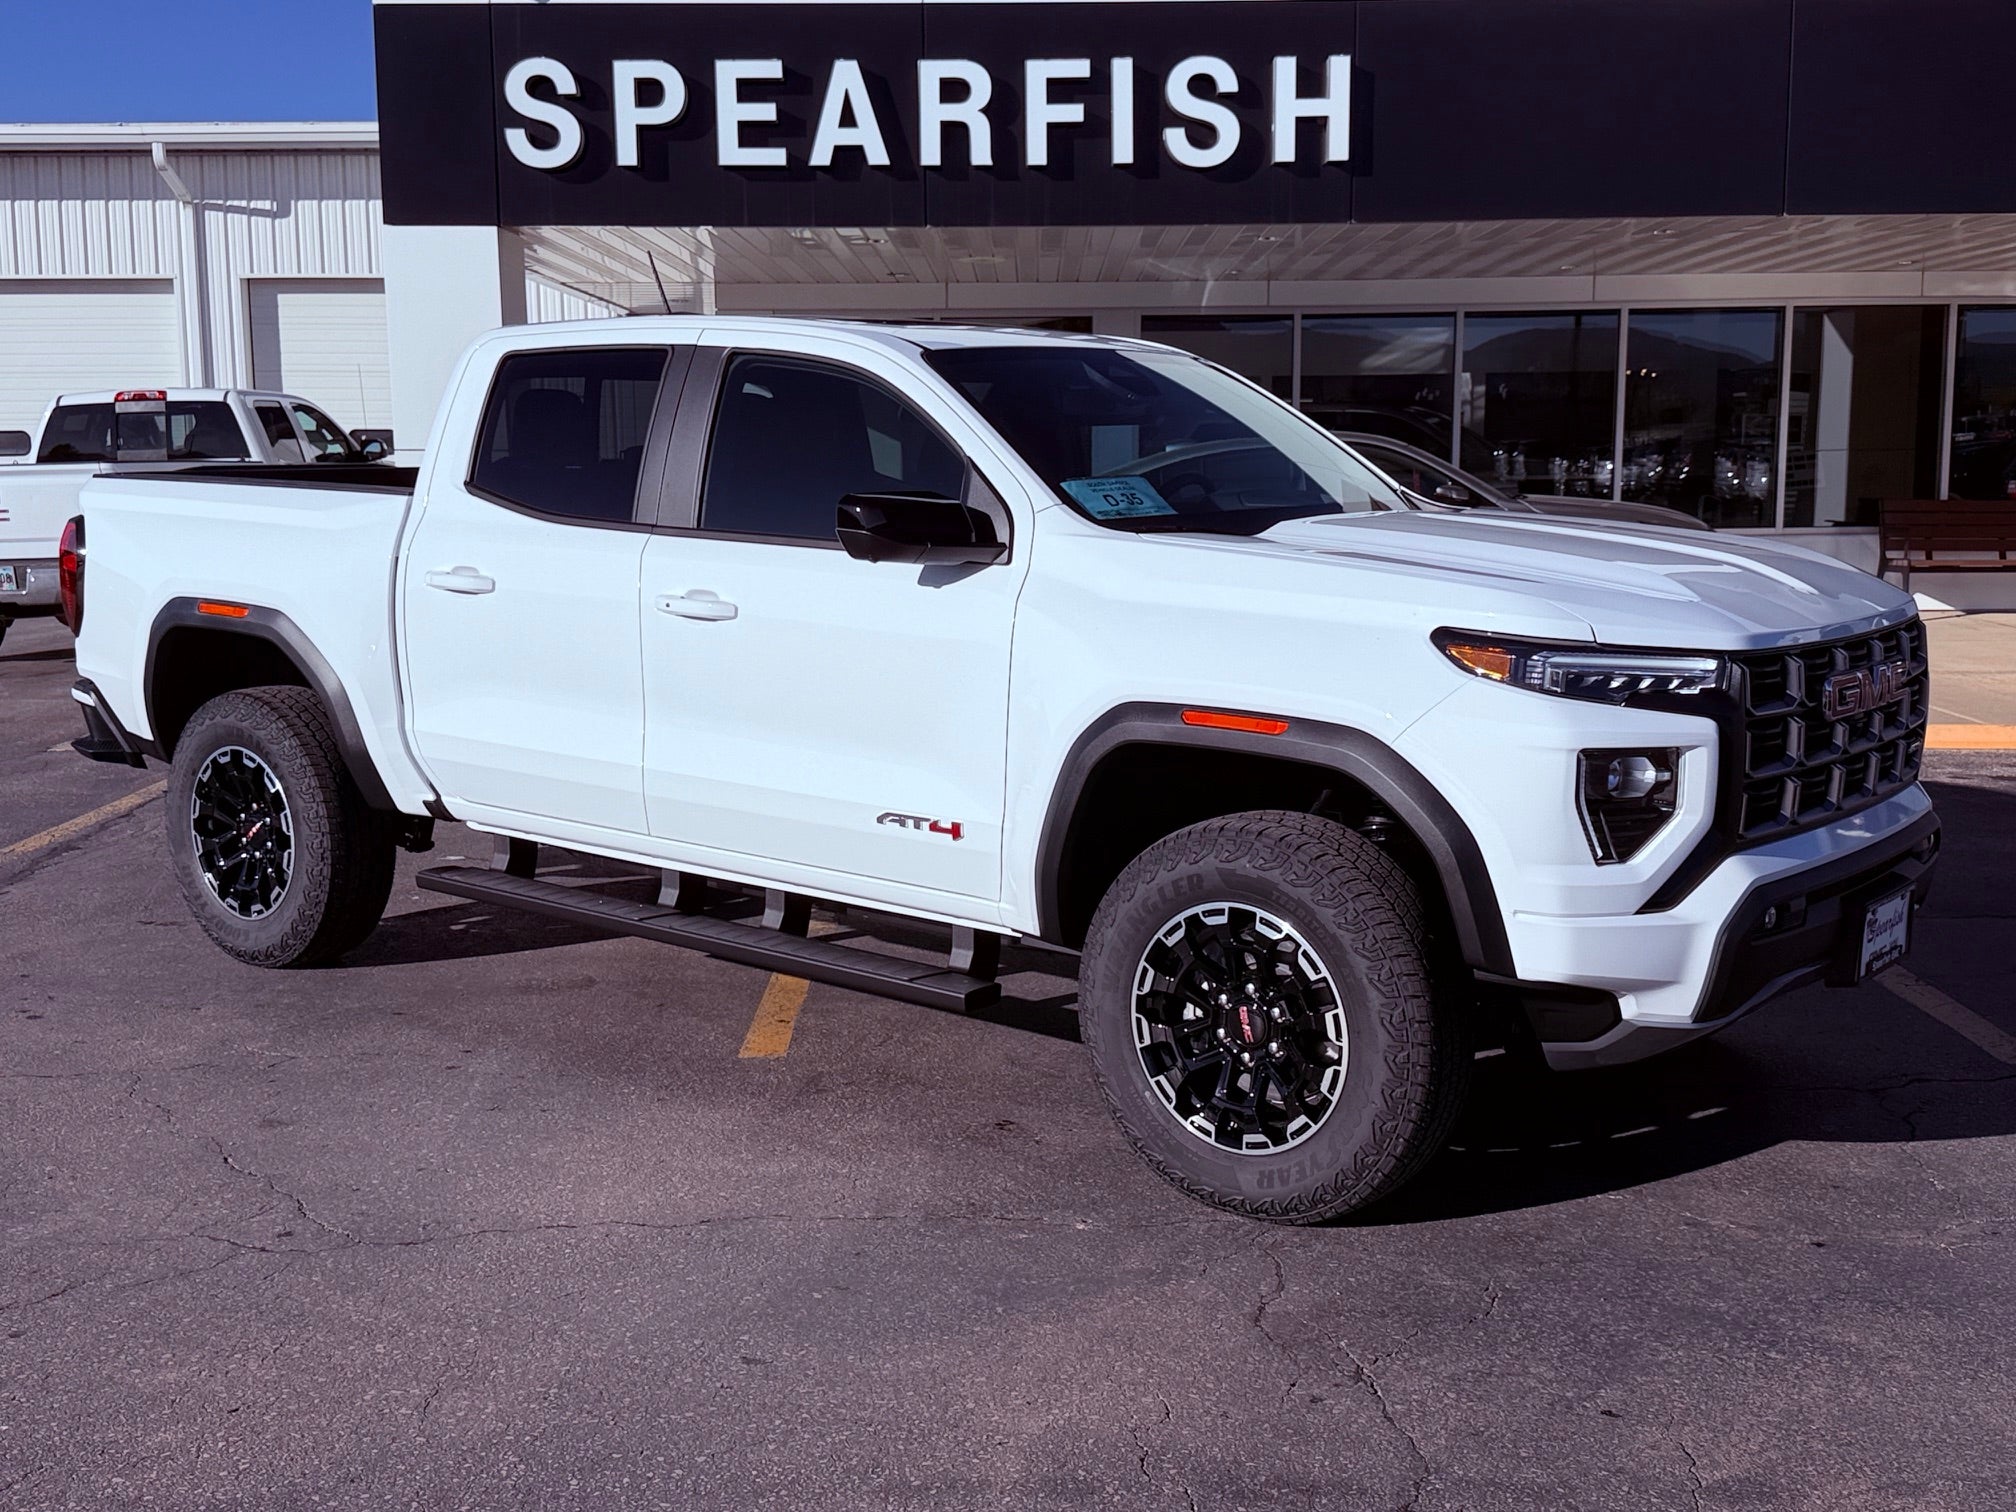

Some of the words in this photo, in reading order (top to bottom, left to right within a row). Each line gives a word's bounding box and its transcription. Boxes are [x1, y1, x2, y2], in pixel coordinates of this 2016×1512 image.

[503, 54, 1351, 170] SPEARFISH
[1102, 493, 1144, 507] D-35
[1823, 661, 1909, 720] GMC
[877, 812, 964, 841] AT4
